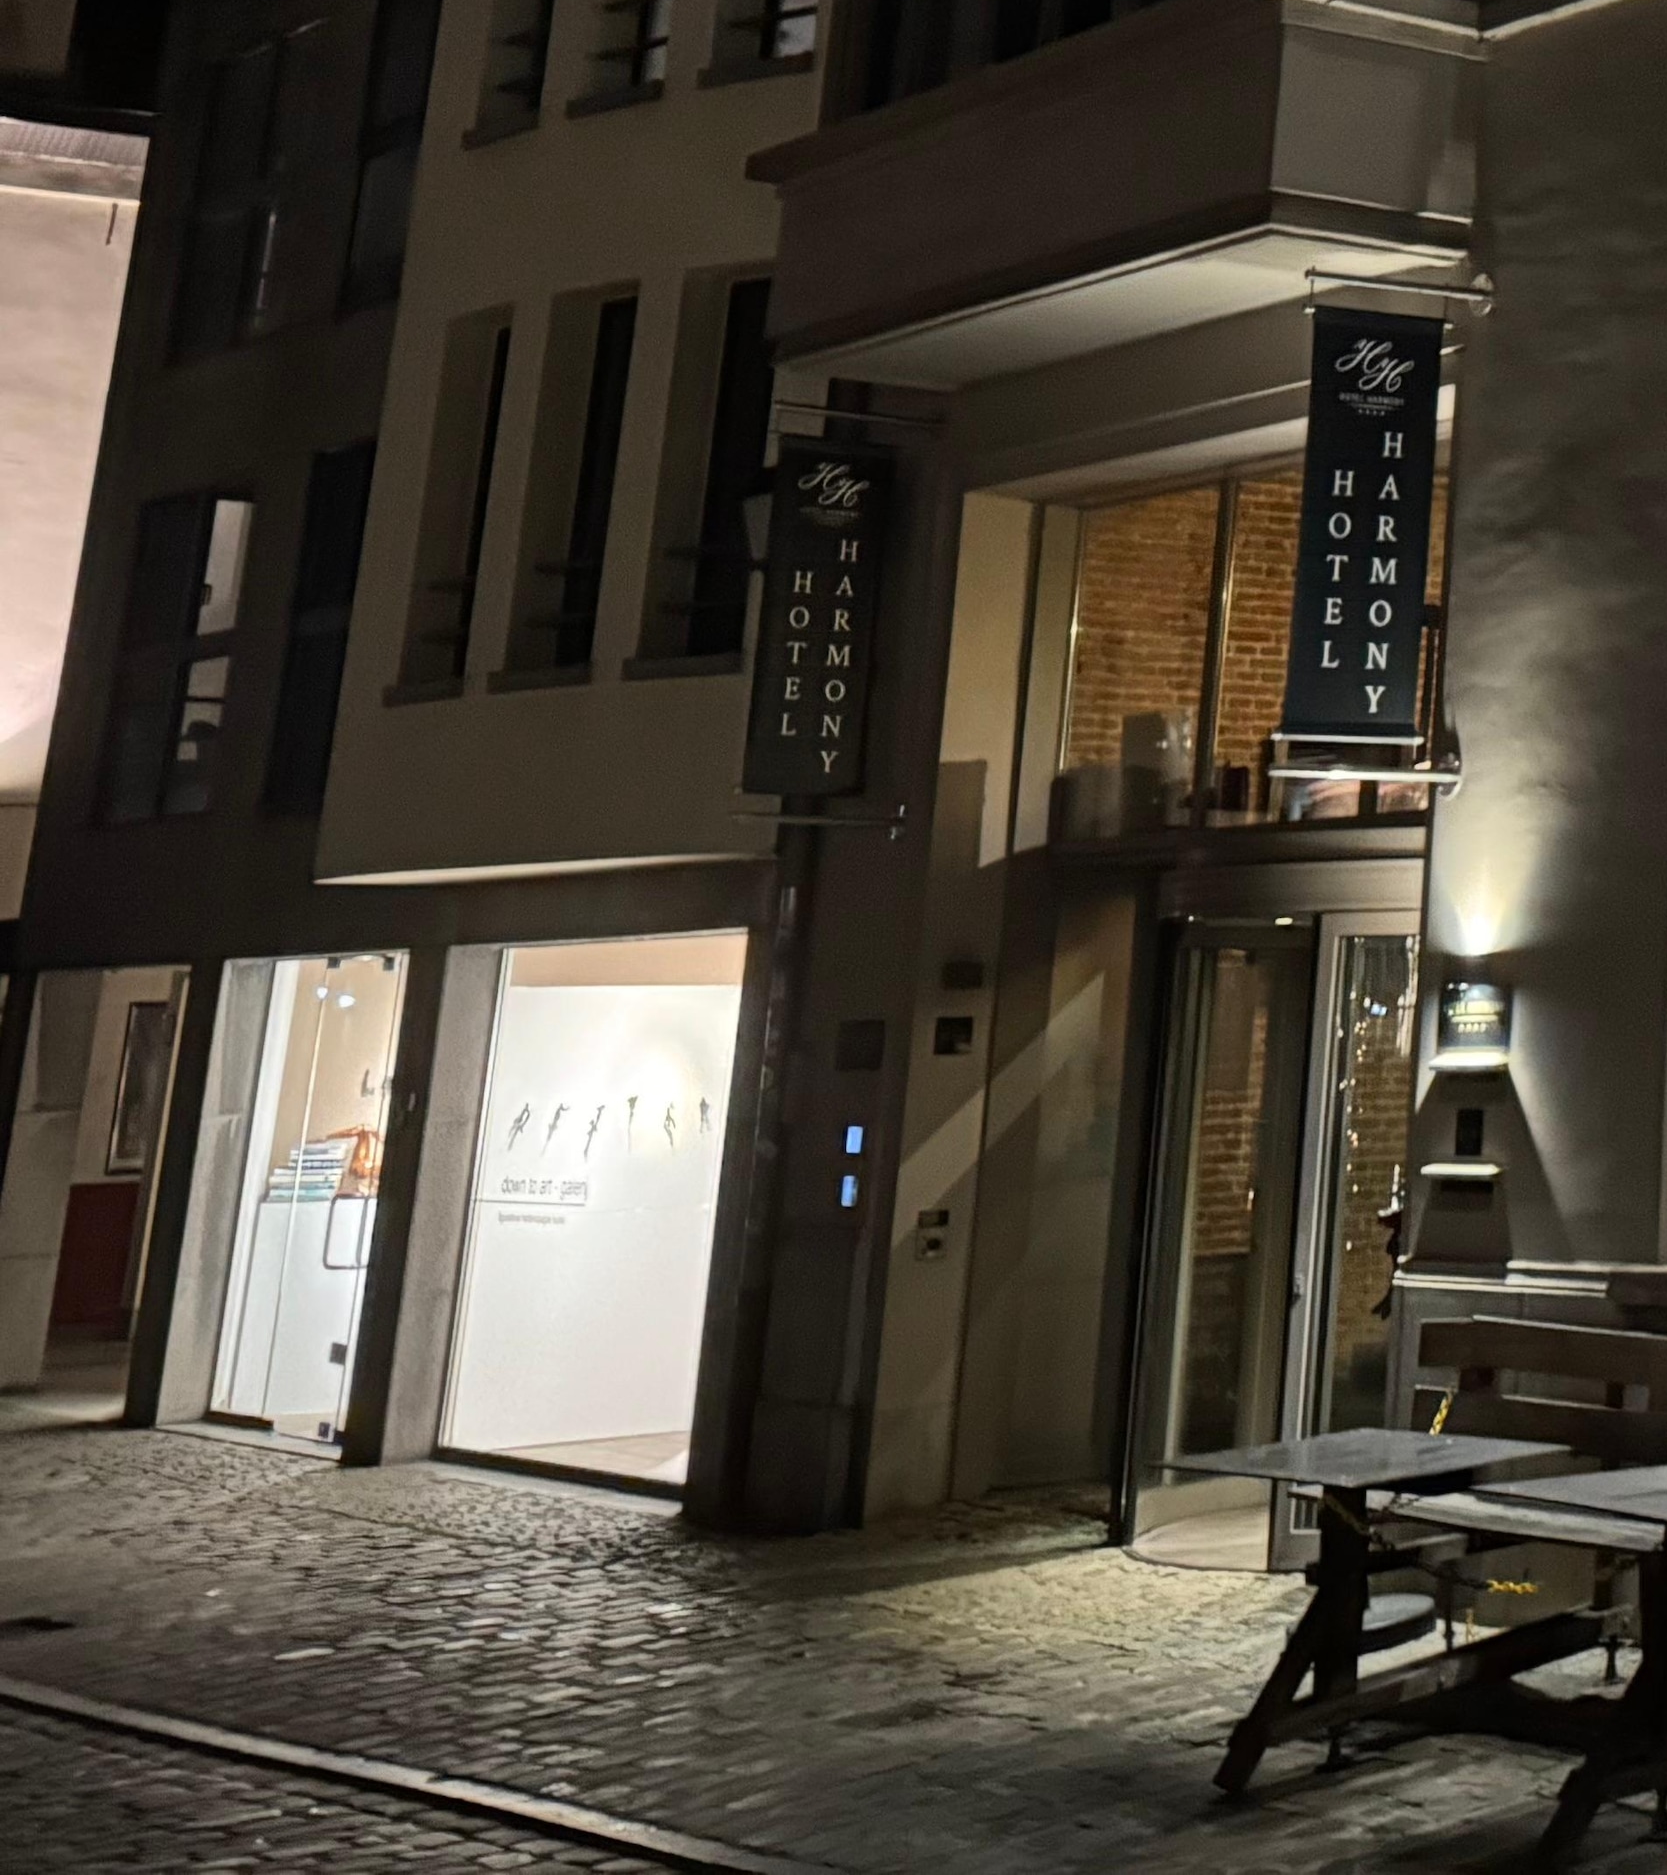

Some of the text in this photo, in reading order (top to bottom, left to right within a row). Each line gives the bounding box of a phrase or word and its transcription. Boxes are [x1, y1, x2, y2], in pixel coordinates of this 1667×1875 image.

[781, 570, 815, 736] HOTEL
[819, 538, 860, 773] HARMONY
[1320, 469, 1355, 669] HOTEL
[1364, 431, 1403, 714] HARMONY
